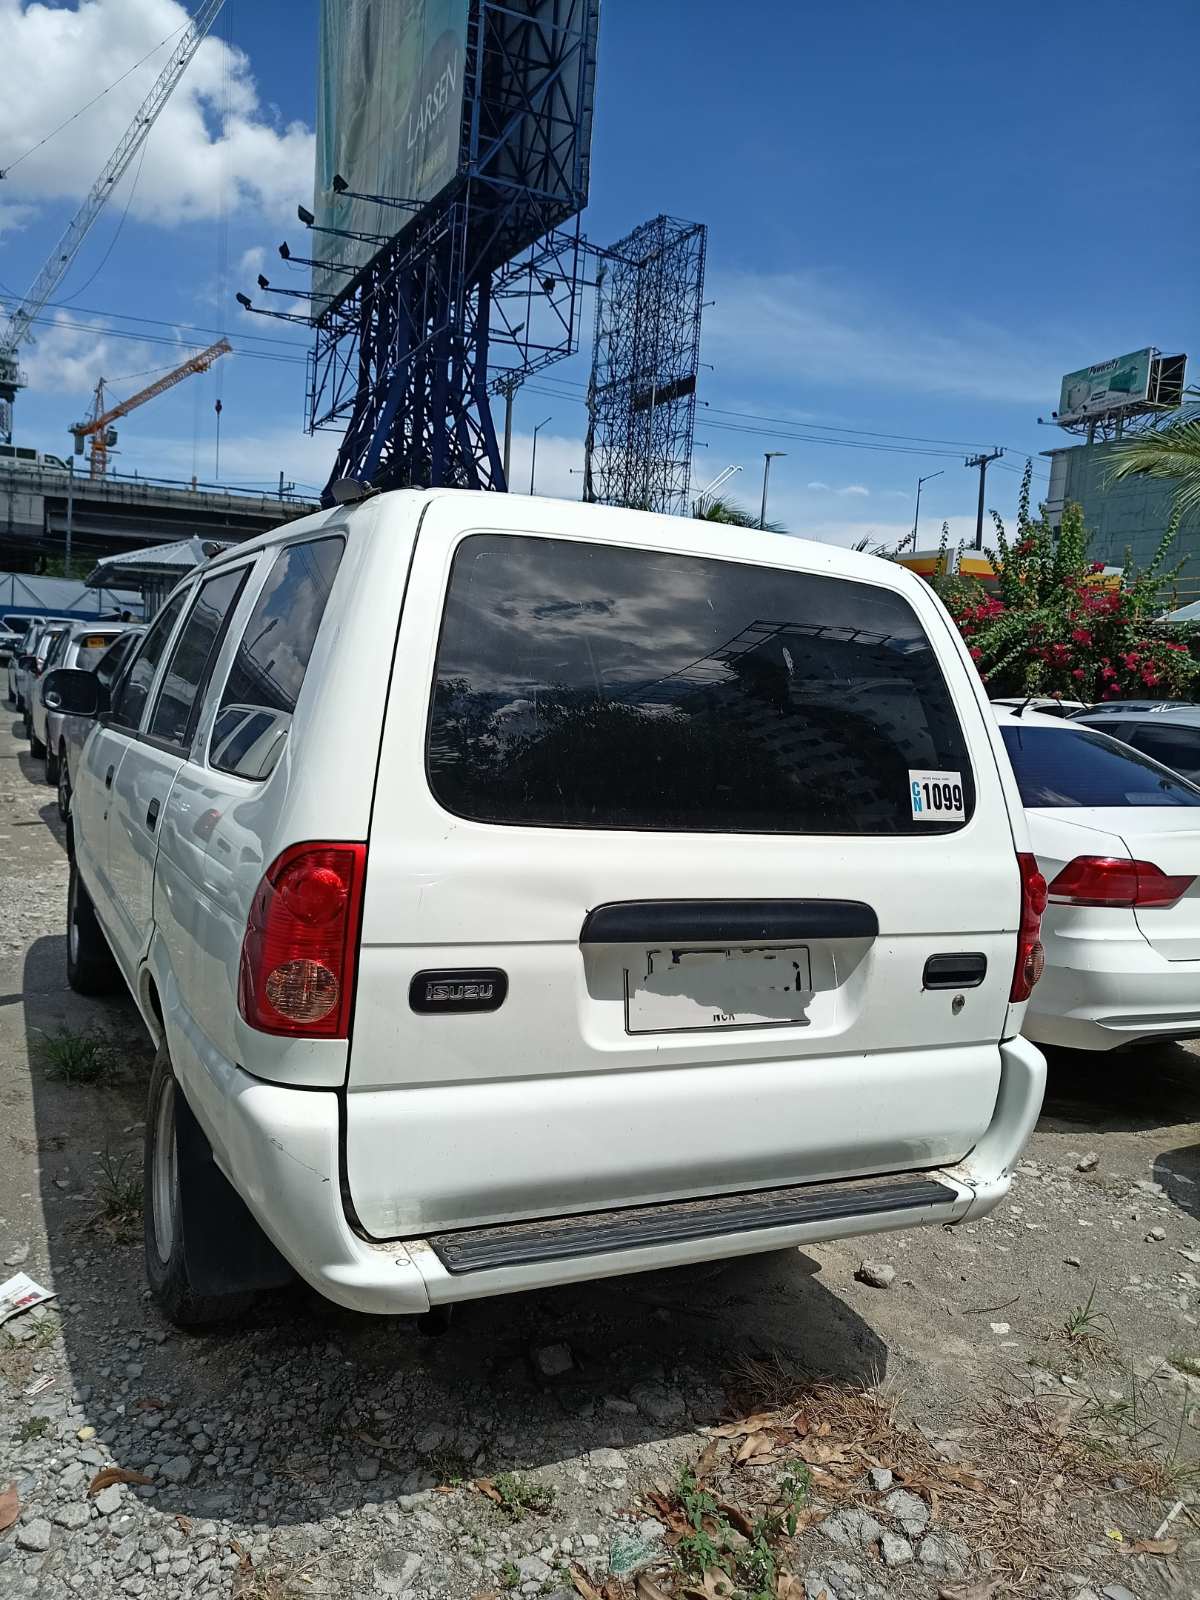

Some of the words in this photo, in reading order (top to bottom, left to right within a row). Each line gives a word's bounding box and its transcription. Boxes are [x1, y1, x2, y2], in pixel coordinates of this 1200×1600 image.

[407, 48, 458, 150] LARSEN
[922, 782, 963, 812] 1099
[426, 983, 494, 1001] ISUZU
